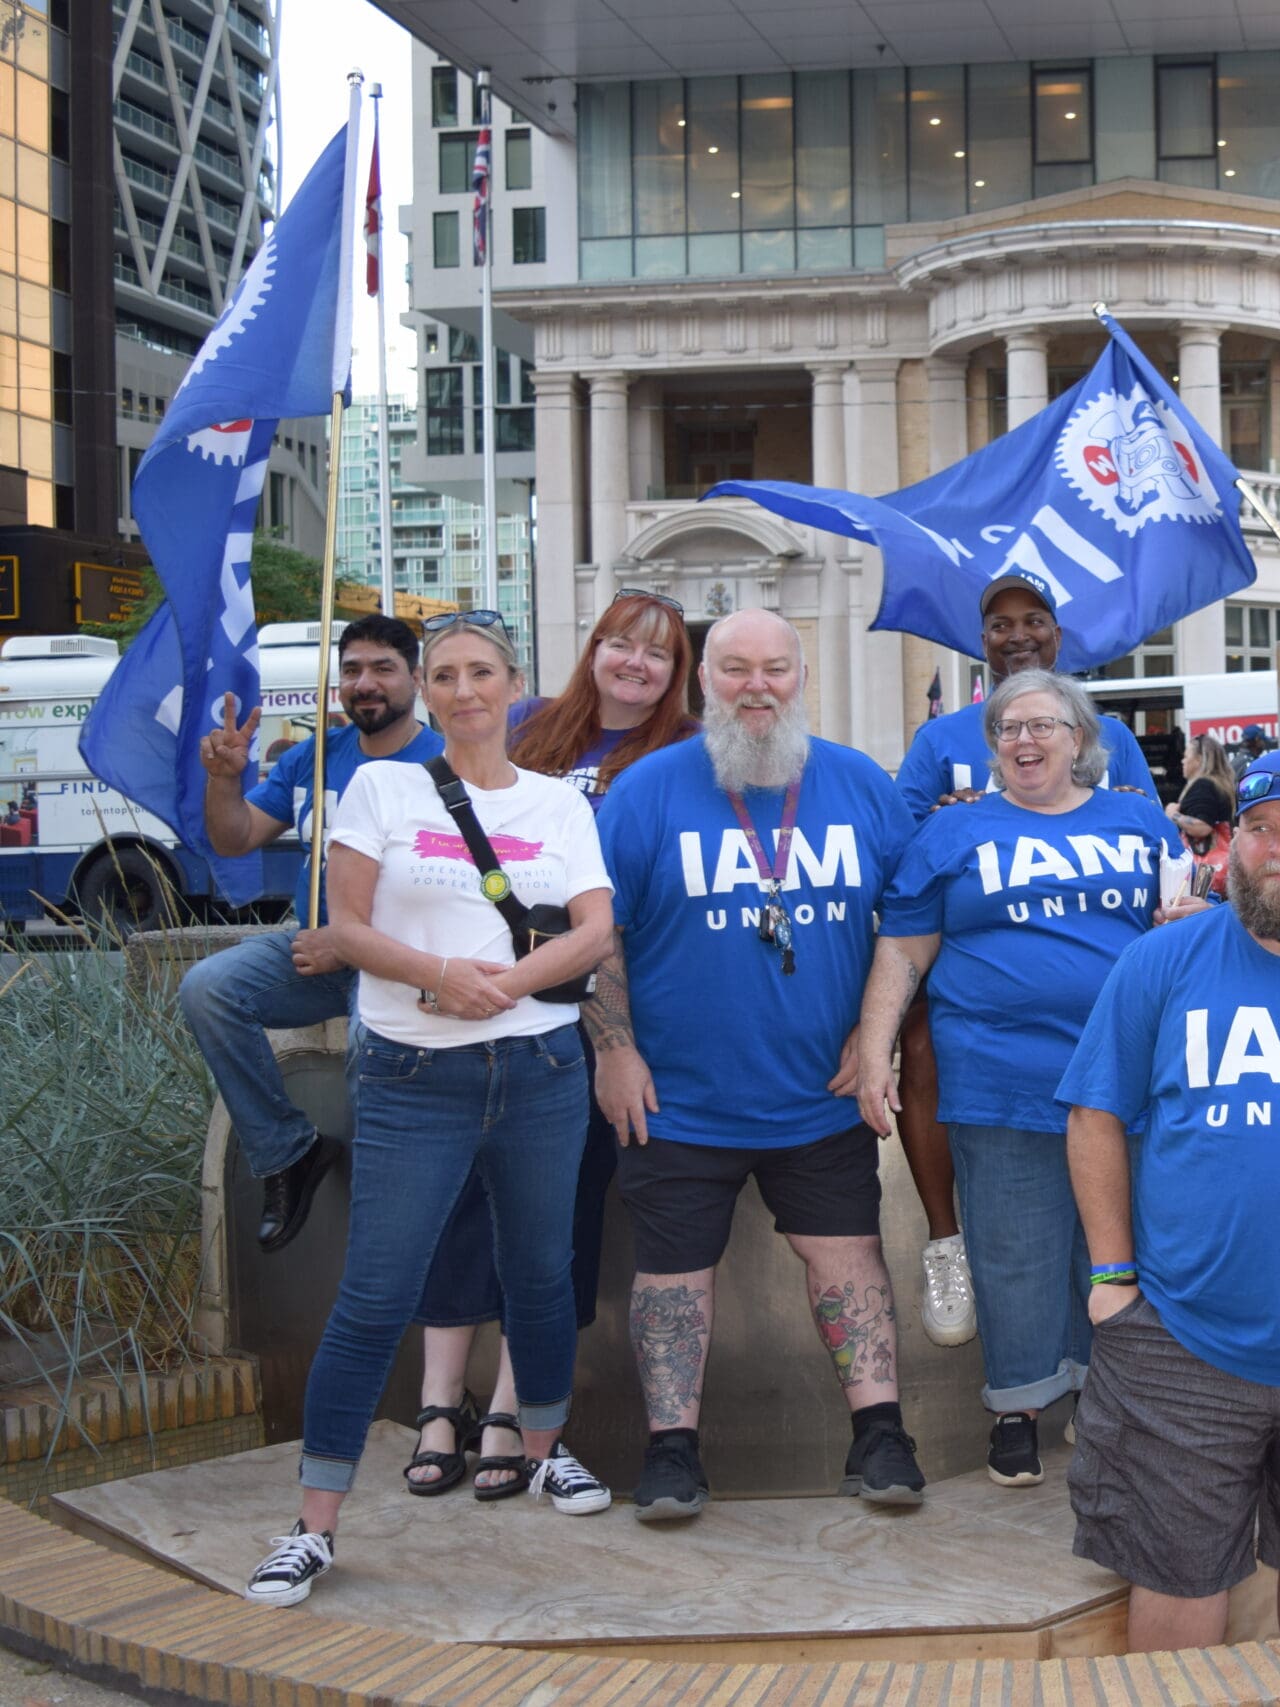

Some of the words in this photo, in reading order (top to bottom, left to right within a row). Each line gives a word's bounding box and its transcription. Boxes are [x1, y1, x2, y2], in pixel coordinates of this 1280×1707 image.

[680, 824, 861, 897] IAM
[976, 834, 1153, 896] IAM
[706, 901, 846, 930] UNON
[1007, 887, 1149, 923] UNION
